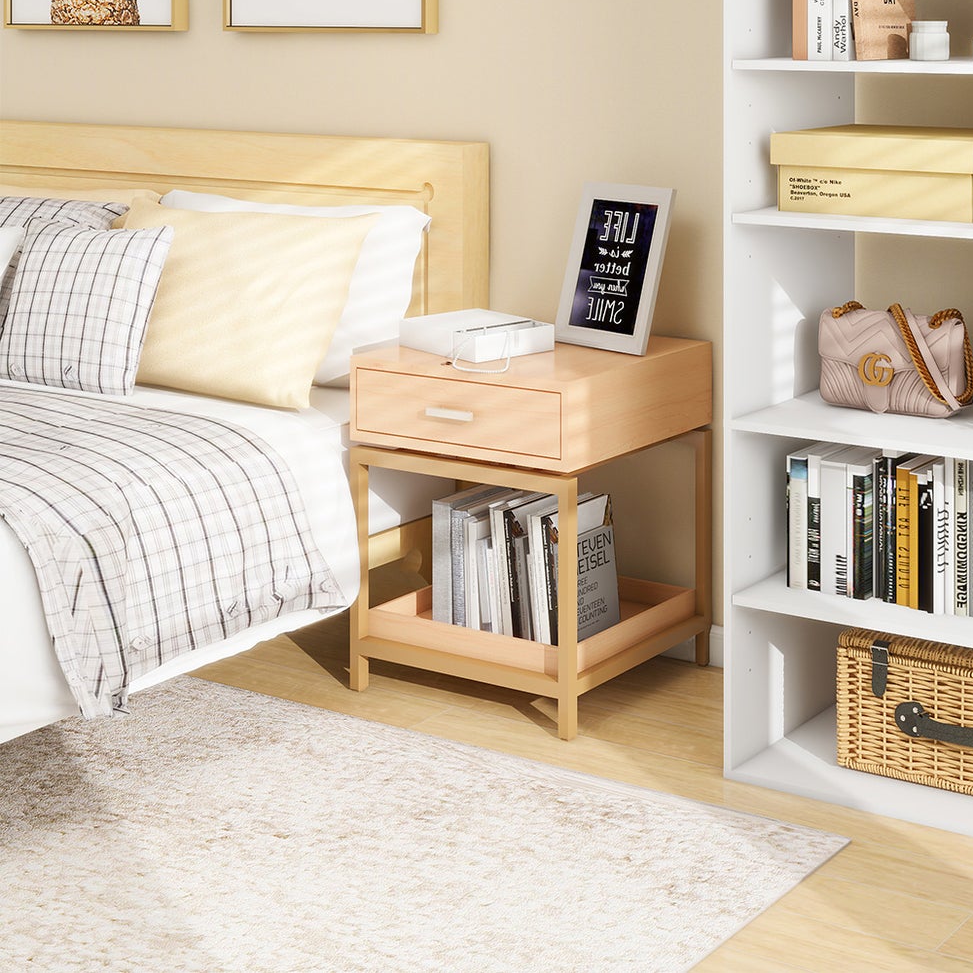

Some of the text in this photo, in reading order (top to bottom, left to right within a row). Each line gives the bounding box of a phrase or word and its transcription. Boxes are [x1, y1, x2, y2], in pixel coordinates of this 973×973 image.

[833, 19, 842, 48] Andy
[577, 531, 612, 558] TEVEN
[577, 550, 610, 576] EISEL
[577, 576, 588, 588] REE
[577, 597, 606, 616] EVENTEEN
